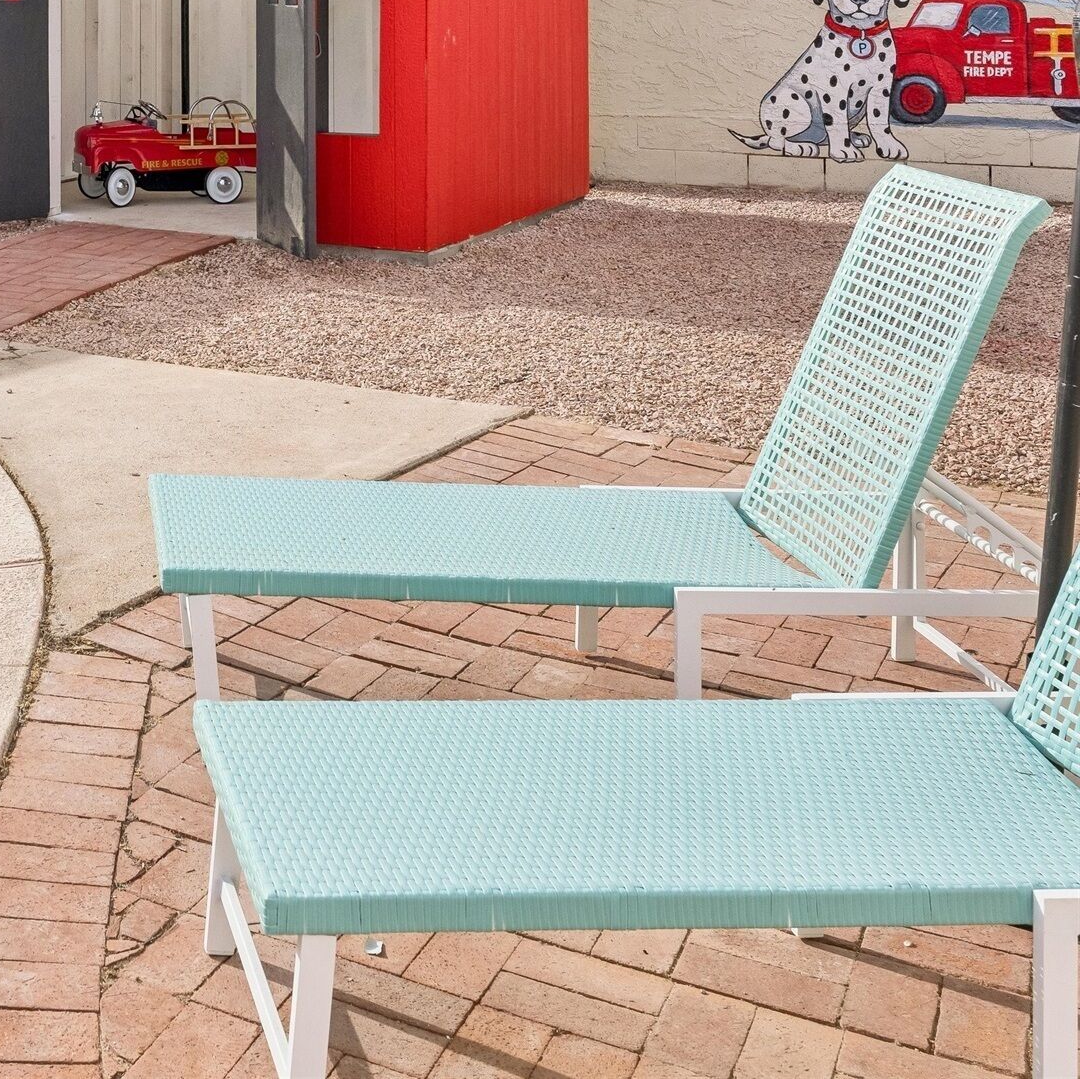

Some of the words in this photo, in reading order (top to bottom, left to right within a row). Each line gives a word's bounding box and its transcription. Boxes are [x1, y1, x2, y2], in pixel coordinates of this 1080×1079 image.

[859, 42, 867, 54] P
[963, 50, 1012, 65] TEMPE
[963, 66, 986, 77] FIRE
[987, 66, 1013, 77] DEPT
[141, 160, 161, 169] FIRE
[162, 160, 170, 168] &
[172, 158, 203, 167] RESCUE
